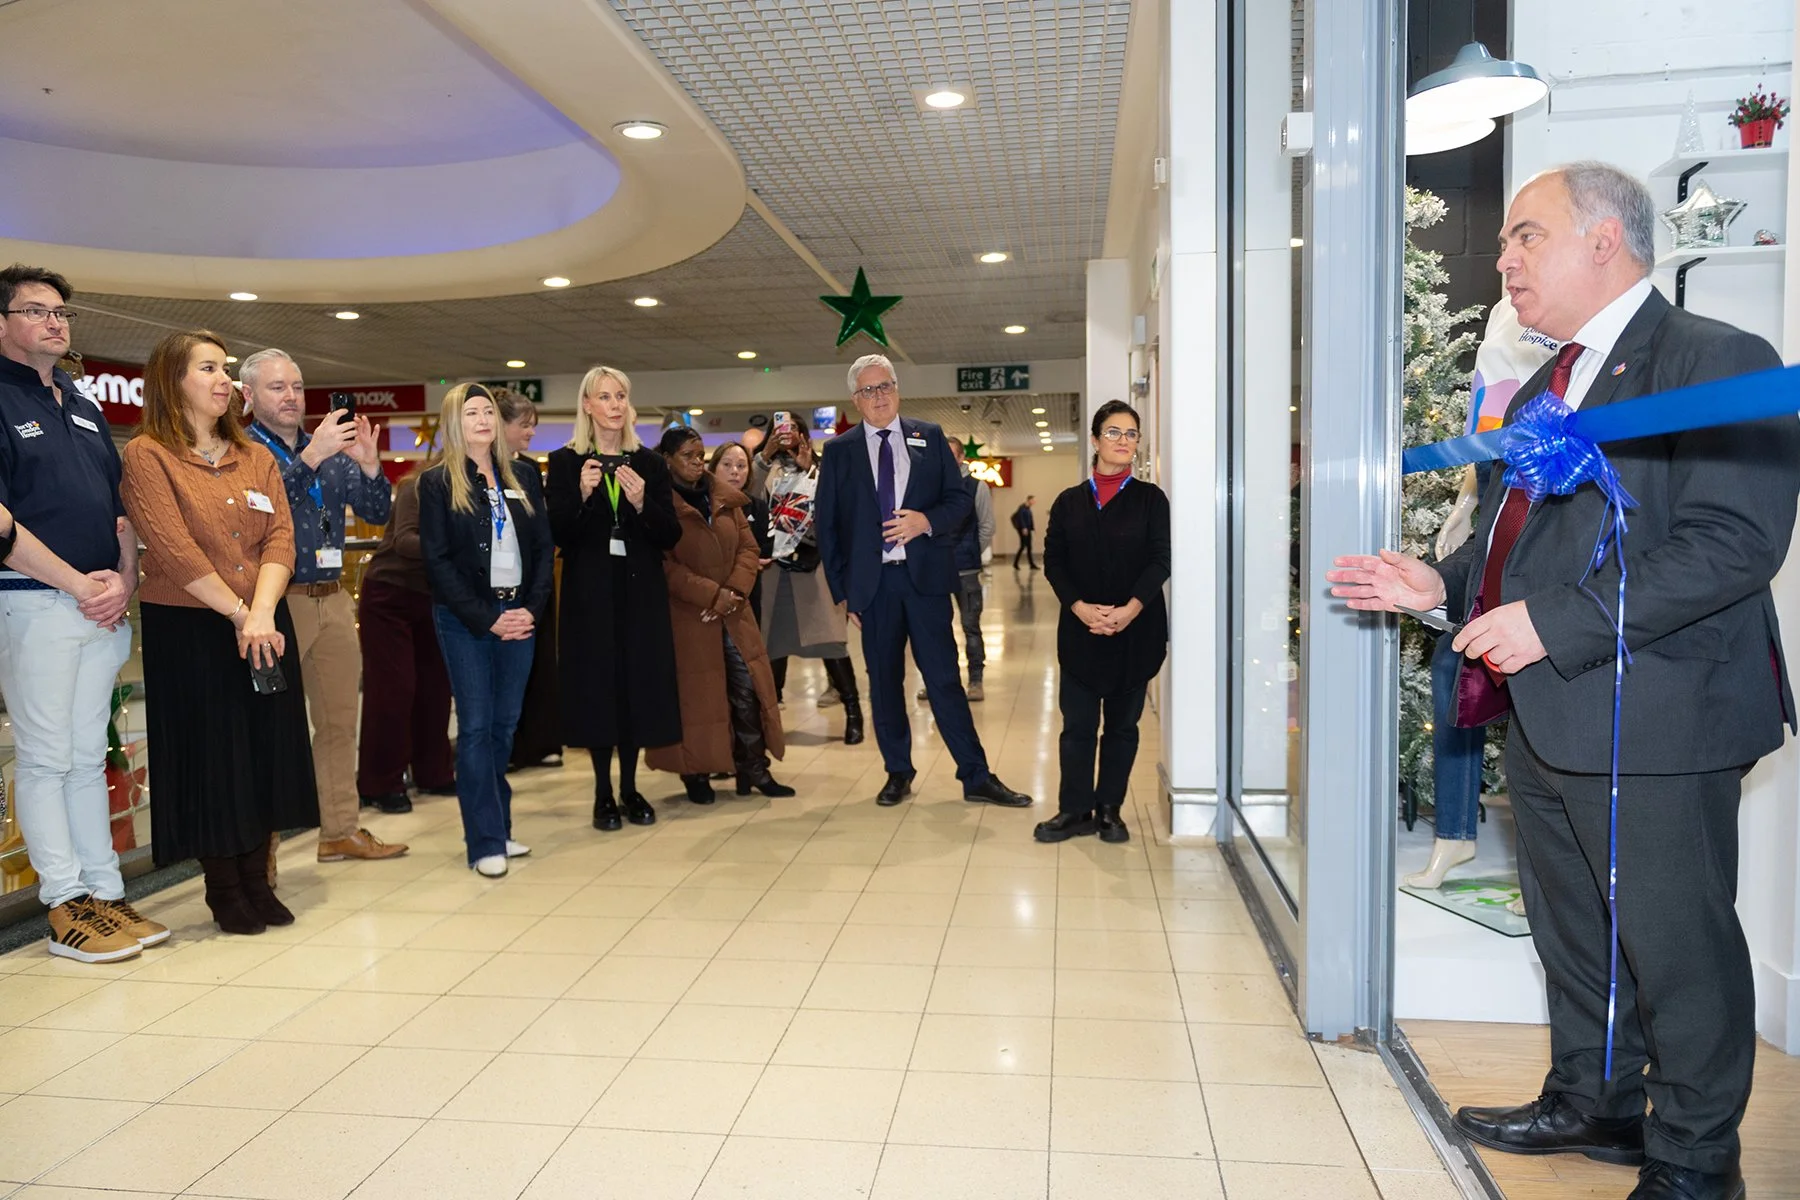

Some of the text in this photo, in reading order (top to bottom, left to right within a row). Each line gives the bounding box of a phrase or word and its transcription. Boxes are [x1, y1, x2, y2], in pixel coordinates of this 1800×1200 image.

[1518, 332, 1558, 351] Hospice
[960, 369, 984, 380] Fire
[960, 380, 984, 390] exit
